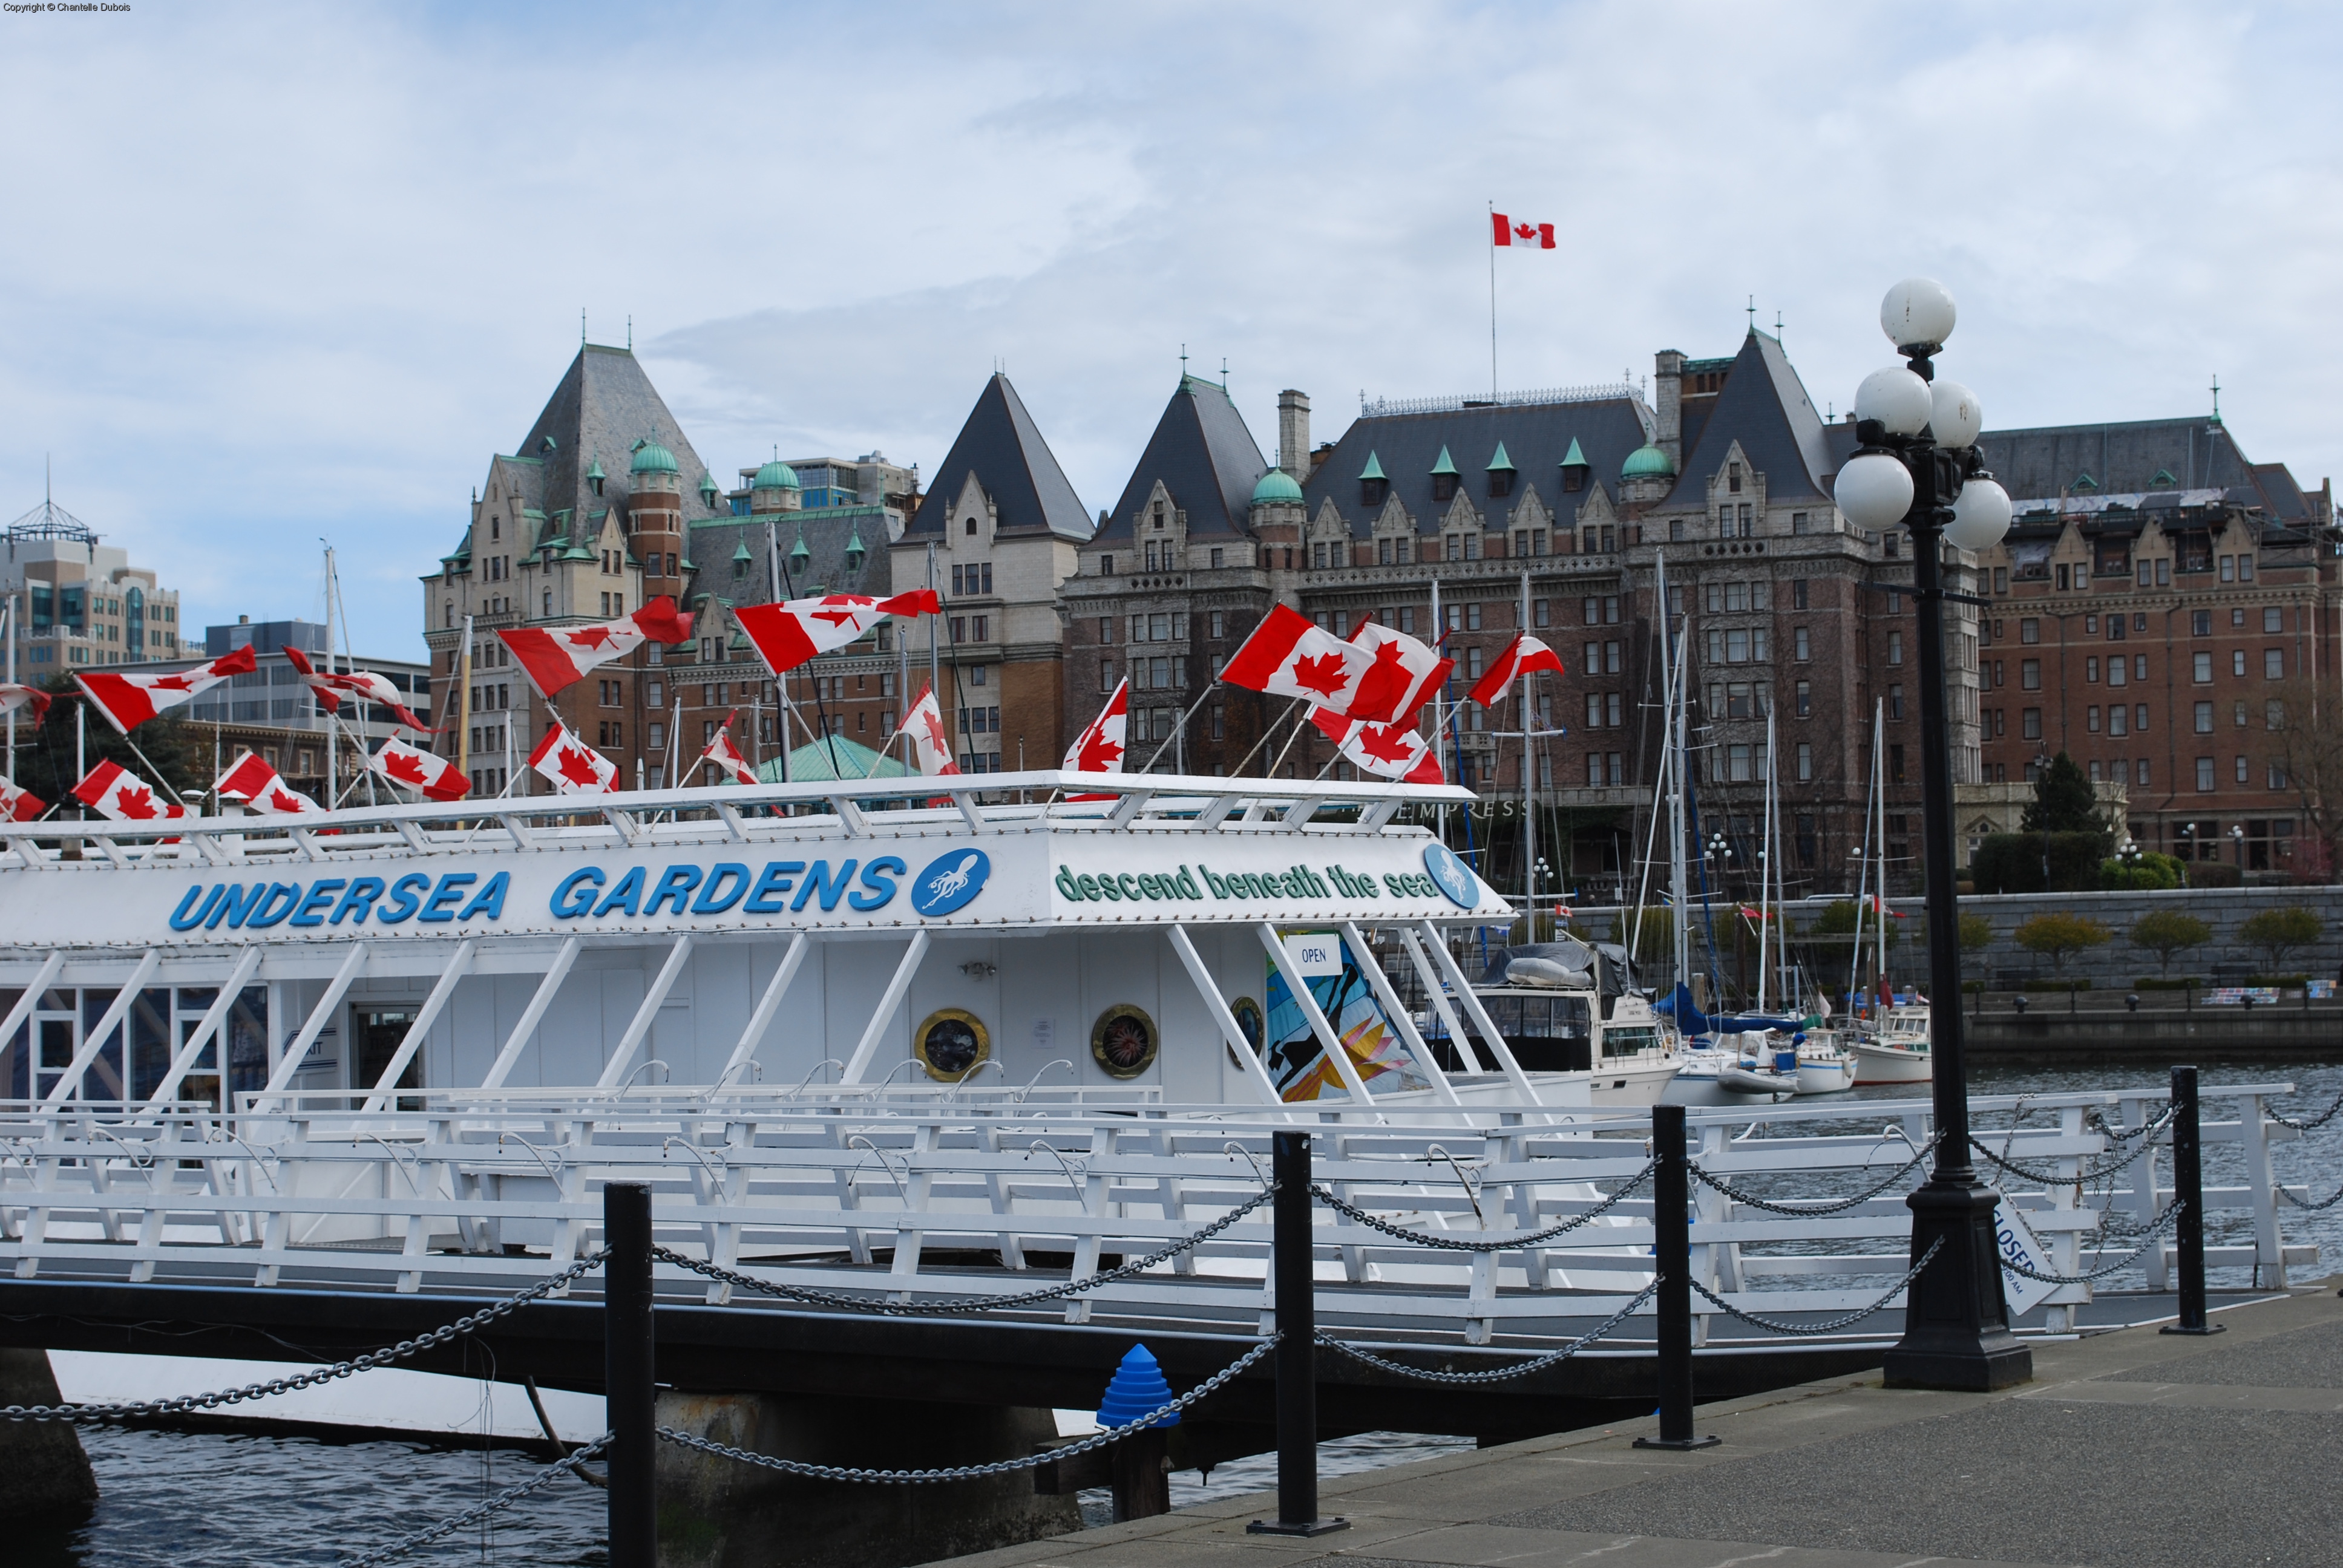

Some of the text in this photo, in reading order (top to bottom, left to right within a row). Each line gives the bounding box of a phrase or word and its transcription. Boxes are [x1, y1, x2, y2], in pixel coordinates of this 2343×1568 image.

[1055, 863, 1440, 903] descend beneath the sea
[169, 855, 907, 932] UNDERSEA GARDENS
[1302, 948, 1327, 963] OPEN
[305, 1041, 323, 1056] XIT
[2011, 1281, 2024, 1295] AM
